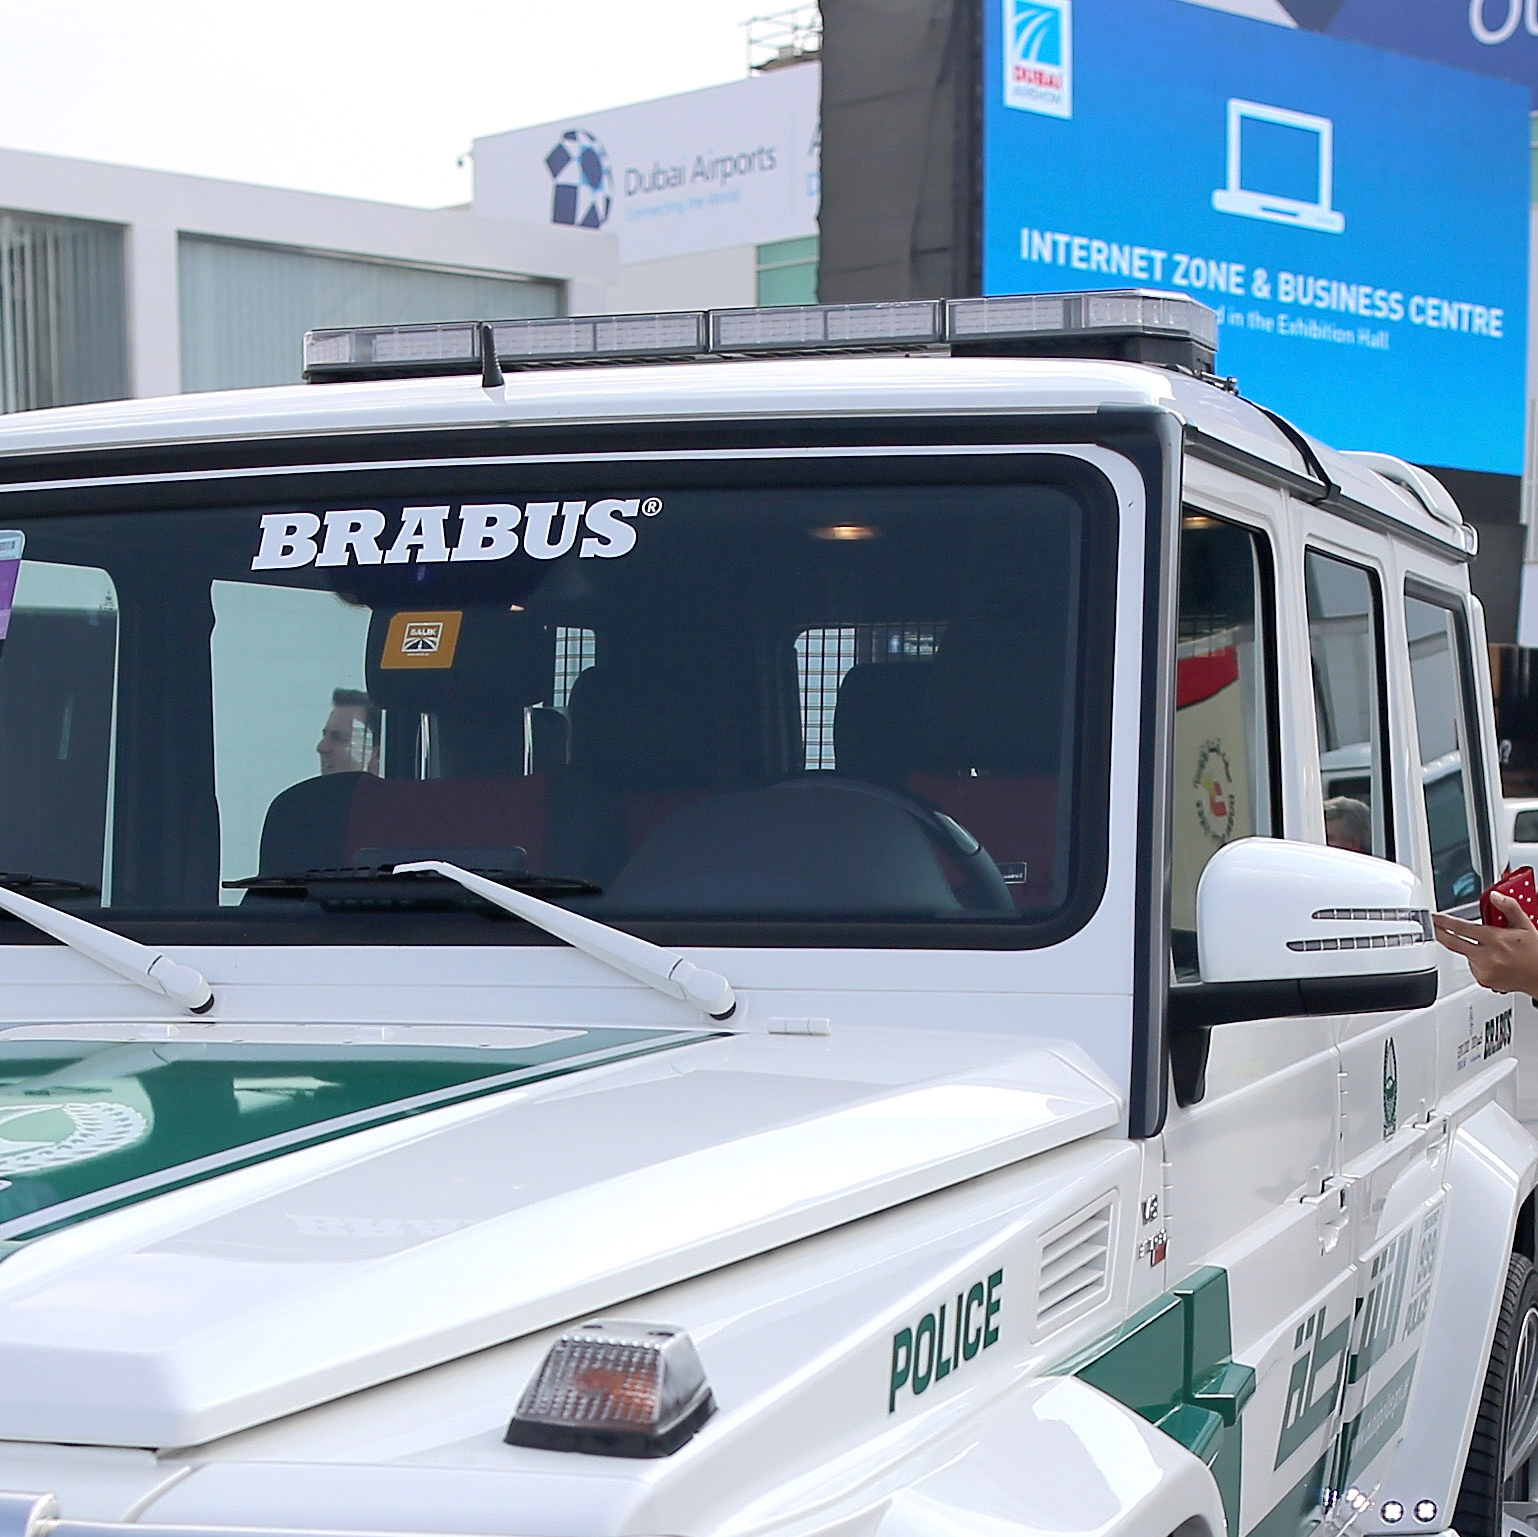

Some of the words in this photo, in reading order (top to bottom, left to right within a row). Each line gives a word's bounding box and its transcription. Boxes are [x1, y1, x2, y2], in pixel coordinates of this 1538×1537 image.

[624, 159, 686, 197] Dubai
[690, 146, 777, 187] Airports
[1020, 227, 1165, 282] INTERNET
[1171, 253, 1245, 296] ZONE
[1252, 267, 1271, 301] &
[1278, 271, 1404, 322] BUSINESS
[1408, 298, 1504, 339] CENTRE
[1228, 306, 1245, 328] in
[1248, 309, 1274, 333] the
[1277, 313, 1355, 346] Exhibition
[1358, 328, 1390, 351] Hall
[1141, 1192, 1158, 1226] V8
[888, 1268, 1004, 1415] POLICE
